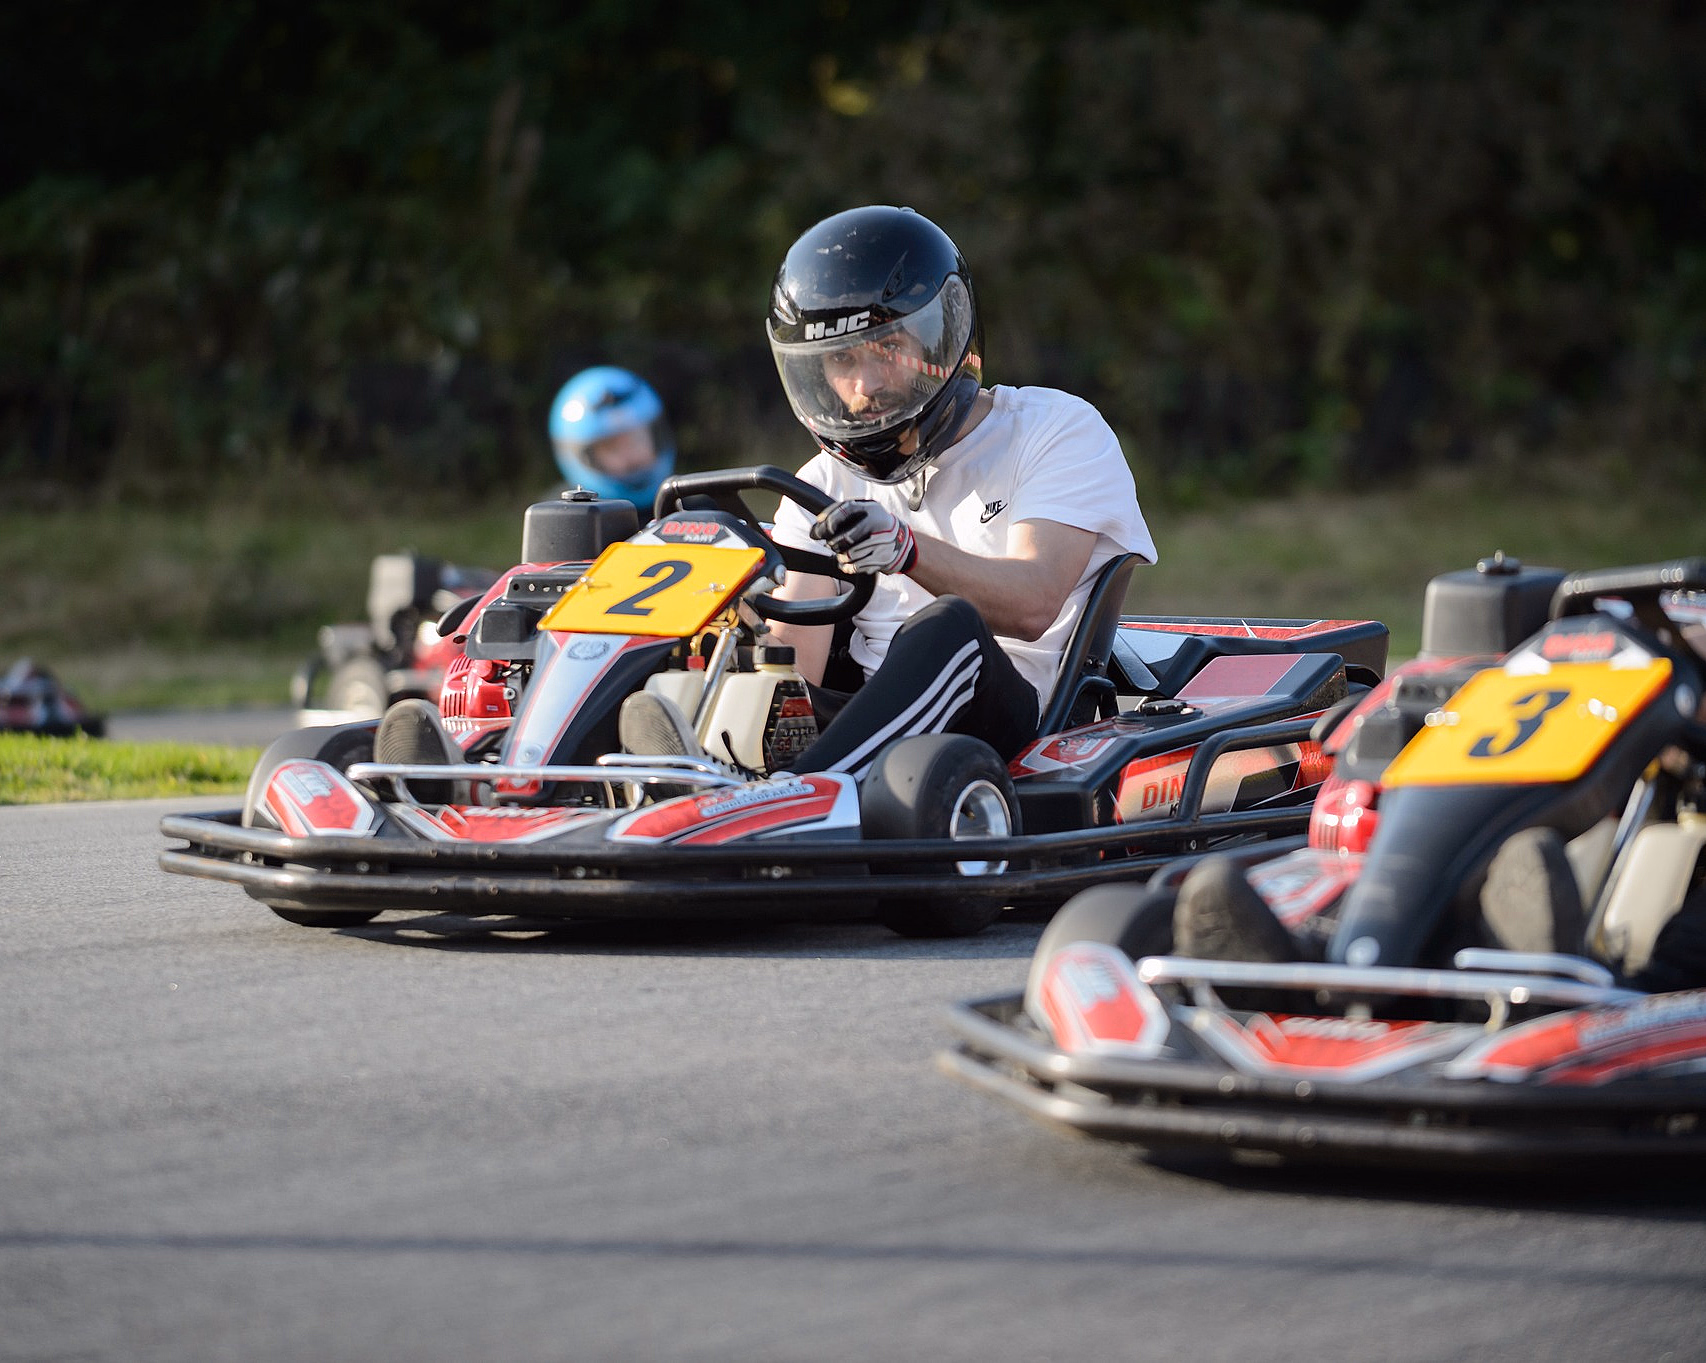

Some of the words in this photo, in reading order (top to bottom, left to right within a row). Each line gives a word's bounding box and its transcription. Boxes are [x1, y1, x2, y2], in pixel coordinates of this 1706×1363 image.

[804, 310, 871, 341] HJC
[984, 499, 1002, 516] NIKE
[661, 520, 721, 536] DINO
[683, 534, 717, 543] KART
[604, 560, 693, 617] 2
[1467, 687, 1572, 759] 3
[1141, 772, 1188, 812] DIN
